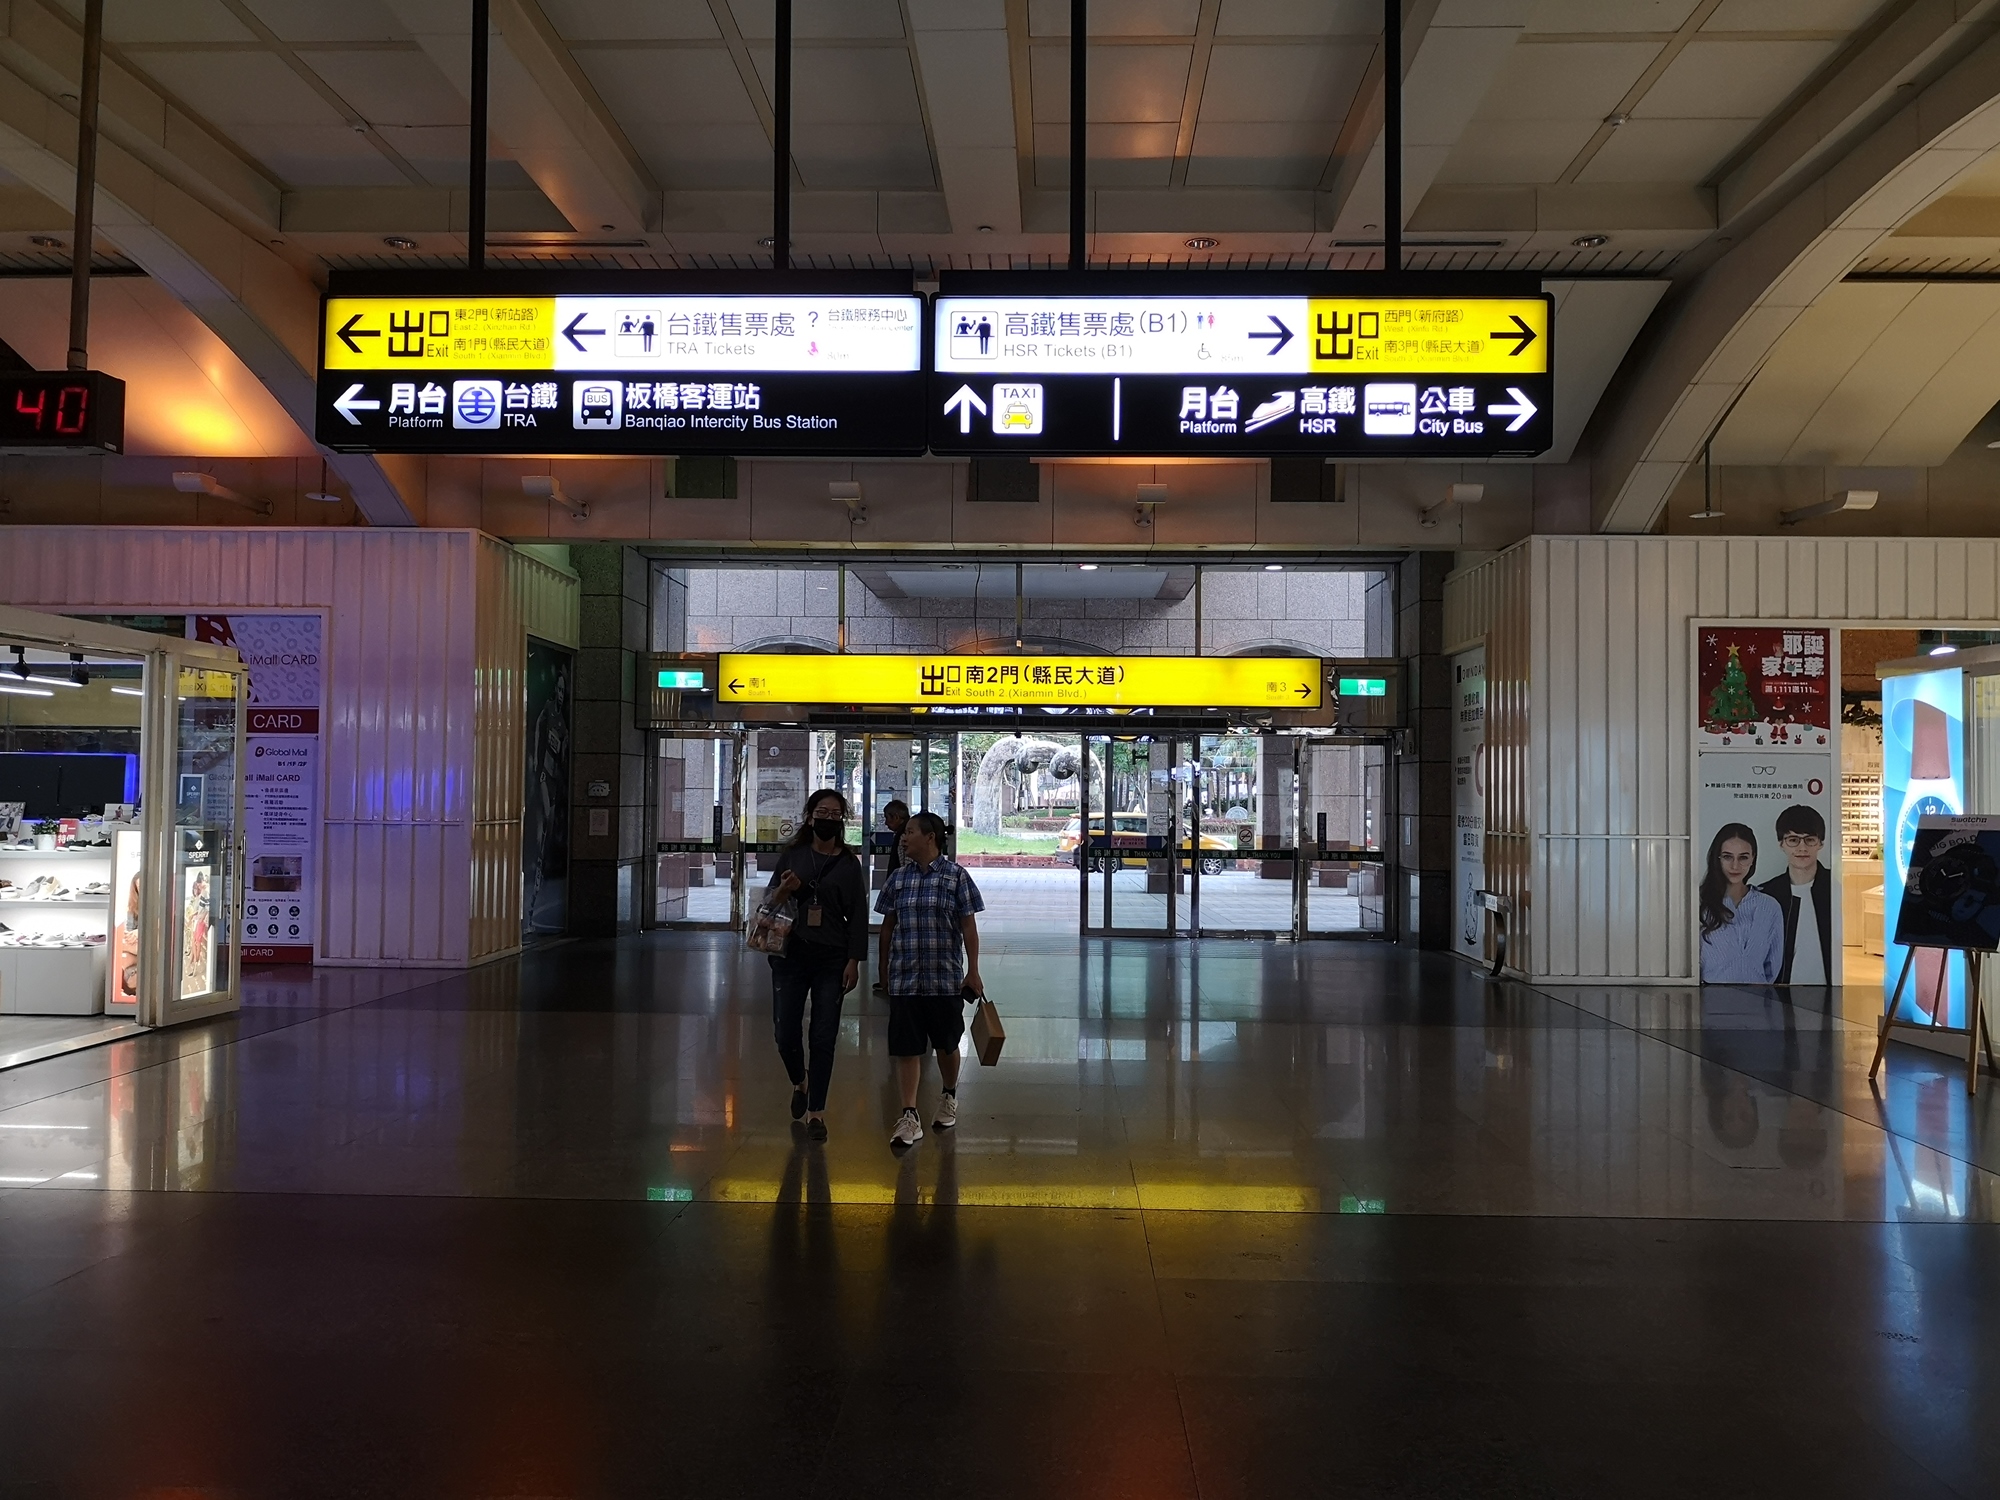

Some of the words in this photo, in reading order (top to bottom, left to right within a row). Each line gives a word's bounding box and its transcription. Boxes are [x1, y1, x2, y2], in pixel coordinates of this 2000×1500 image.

[455, 308, 539, 322] 東2門(新站路)
[828, 308, 908, 322] 台鐵服務中心
[1384, 309, 1464, 323] 西門(新府路)
[453, 323, 471, 332] East
[667, 312, 796, 337] 台鐵售票處
[388, 310, 450, 357] 出口
[1316, 311, 1380, 360] 出口
[427, 344, 449, 358] Exit
[453, 338, 550, 351] 南1門(縣民大道)
[667, 342, 699, 355] TRA
[704, 342, 756, 355] Tickets
[1004, 344, 1038, 357] HSR
[1044, 344, 1096, 357] Tickets
[1101, 344, 1133, 359] (B1)
[1384, 340, 1485, 353] 南3門(縣民大道)
[453, 352, 475, 360] South
[1356, 346, 1379, 360] Exit
[388, 382, 447, 415] 月台
[504, 382, 558, 409] 台鐵
[587, 394, 608, 403] BUS
[625, 382, 761, 410] 板橋客運站
[1000, 388, 1036, 399] TAXI
[1300, 386, 1356, 414] 高鐵
[1420, 386, 1475, 414] 公車
[1179, 385, 1240, 419] 月台
[389, 417, 443, 428] Platform
[504, 414, 537, 427] TRA
[625, 414, 686, 430] Banqiao
[691, 415, 749, 431] Intercity
[753, 415, 782, 428] Bus
[786, 415, 838, 429] Station
[1180, 421, 1237, 434] Platform
[1300, 419, 1336, 433] HSR
[1419, 419, 1449, 436] City
[1453, 419, 1484, 434] Bus
[1783, 634, 1825, 656] 耶誕
[250, 654, 278, 665] iMall
[281, 654, 317, 665] CARD
[1761, 656, 1825, 677] 家年華
[966, 665, 1125, 686] 南2門(縣民大道)
[1462, 665, 1485, 680] OWNDAY
[748, 677, 766, 688] 南1
[921, 665, 961, 696] 出口
[1266, 682, 1288, 693] 南3
[946, 687, 961, 697] Exit
[966, 688, 995, 697] South
[1057, 688, 1088, 699] Blvd.)
[253, 714, 302, 728] CARD
[265, 748, 291, 756] Global
[292, 748, 308, 756] Mall
[276, 774, 301, 782] CARD
[1949, 835, 1977, 847] BOLD
[1134, 850, 1151, 858] THANK
[1151, 850, 1163, 858] YOU
[249, 949, 274, 957] CARD
